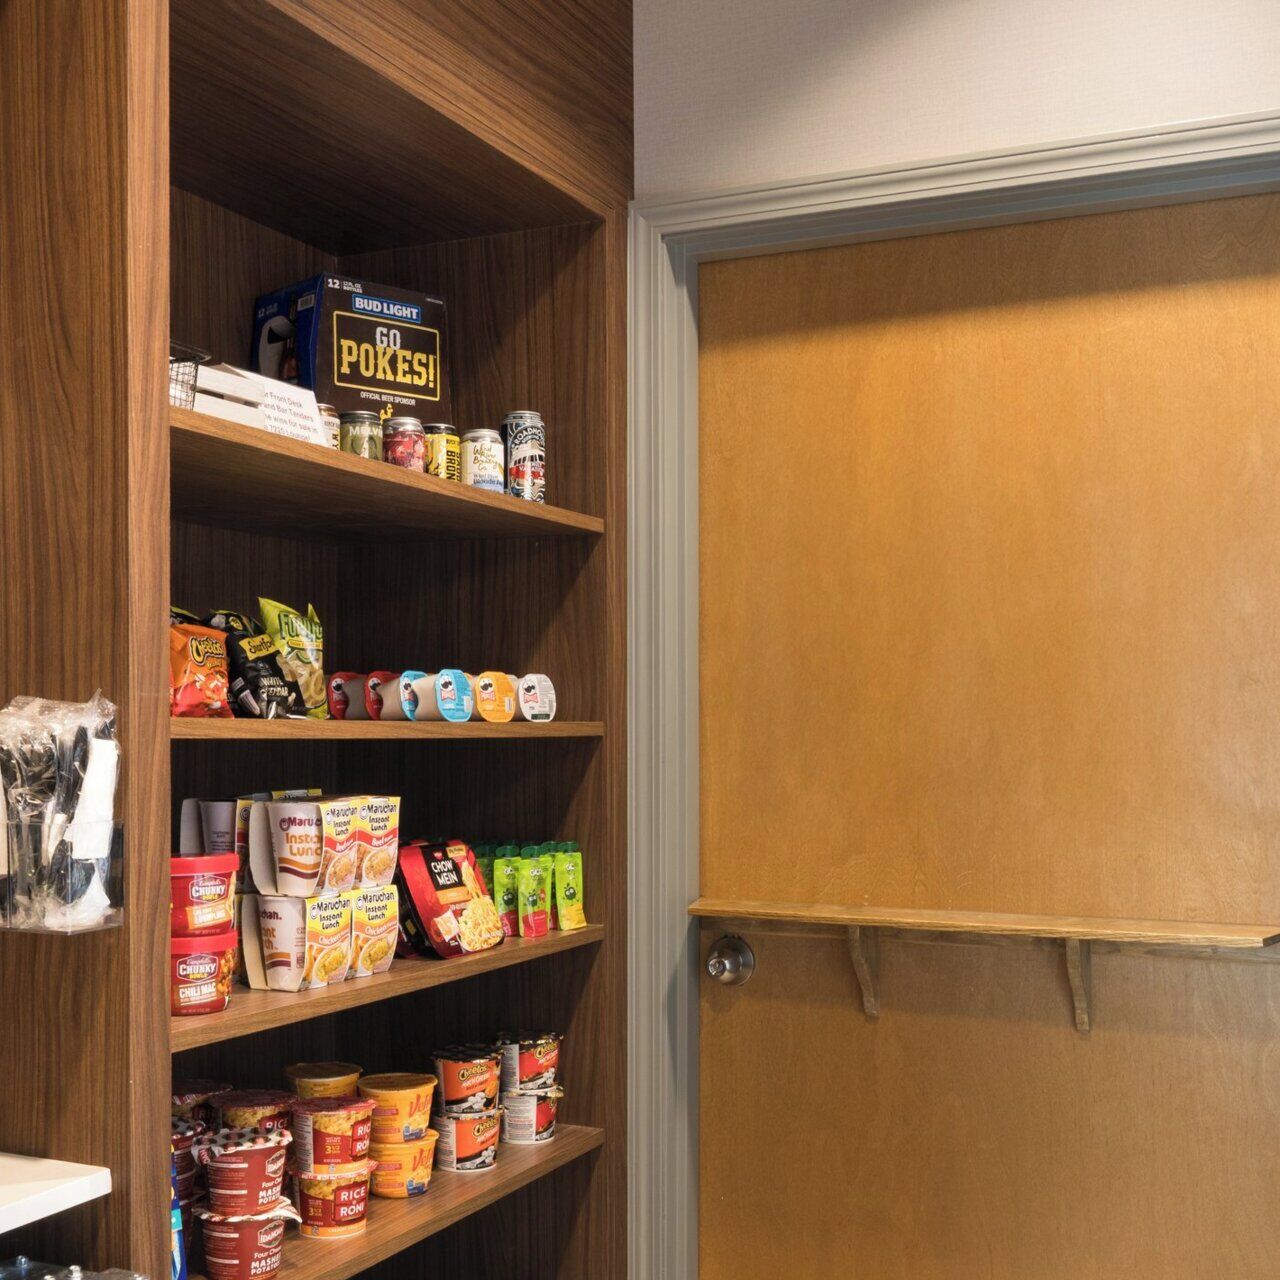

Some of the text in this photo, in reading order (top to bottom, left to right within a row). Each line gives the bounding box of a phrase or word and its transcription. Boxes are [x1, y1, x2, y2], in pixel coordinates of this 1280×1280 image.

[327, 278, 340, 290] 12
[355, 296, 382, 313] BUD
[383, 301, 420, 320] LIGHT
[375, 326, 401, 350] GO
[340, 338, 436, 389] POKES!
[360, 390, 416, 406] OFFICIAL BEER SPONSOR
[349, 425, 383, 437] MELVI
[446, 450, 456, 481] BRON
[330, 806, 358, 817] Maruchan
[367, 803, 397, 814] Maruchan
[333, 819, 351, 828] Instant
[368, 815, 390, 824] Instant
[335, 828, 349, 836] Lunch
[370, 823, 387, 832] Lunch
[285, 832, 320, 844] Insta
[289, 845, 322, 857] Lunc
[430, 859, 454, 873] CHOW
[435, 872, 458, 886] MEIN
[192, 884, 226, 898] CHUNKY
[362, 891, 395, 904] Maruchan
[317, 898, 351, 912] Maruchan
[365, 904, 388, 913] Instant
[319, 913, 343, 923] Instant
[367, 912, 386, 921] Lunch
[322, 921, 340, 930] Lunch
[179, 963, 217, 975] CHUNKY
[179, 982, 217, 999] CHILI MAC
[458, 1064, 488, 1081] Cheetos
[357, 1123, 371, 1137] RIC
[355, 1140, 370, 1153] RON
[259, 1184, 283, 1198] MASH
[340, 1184, 366, 1201] RICE
[340, 1203, 365, 1217] RONI
[254, 1250, 268, 1260] Four
